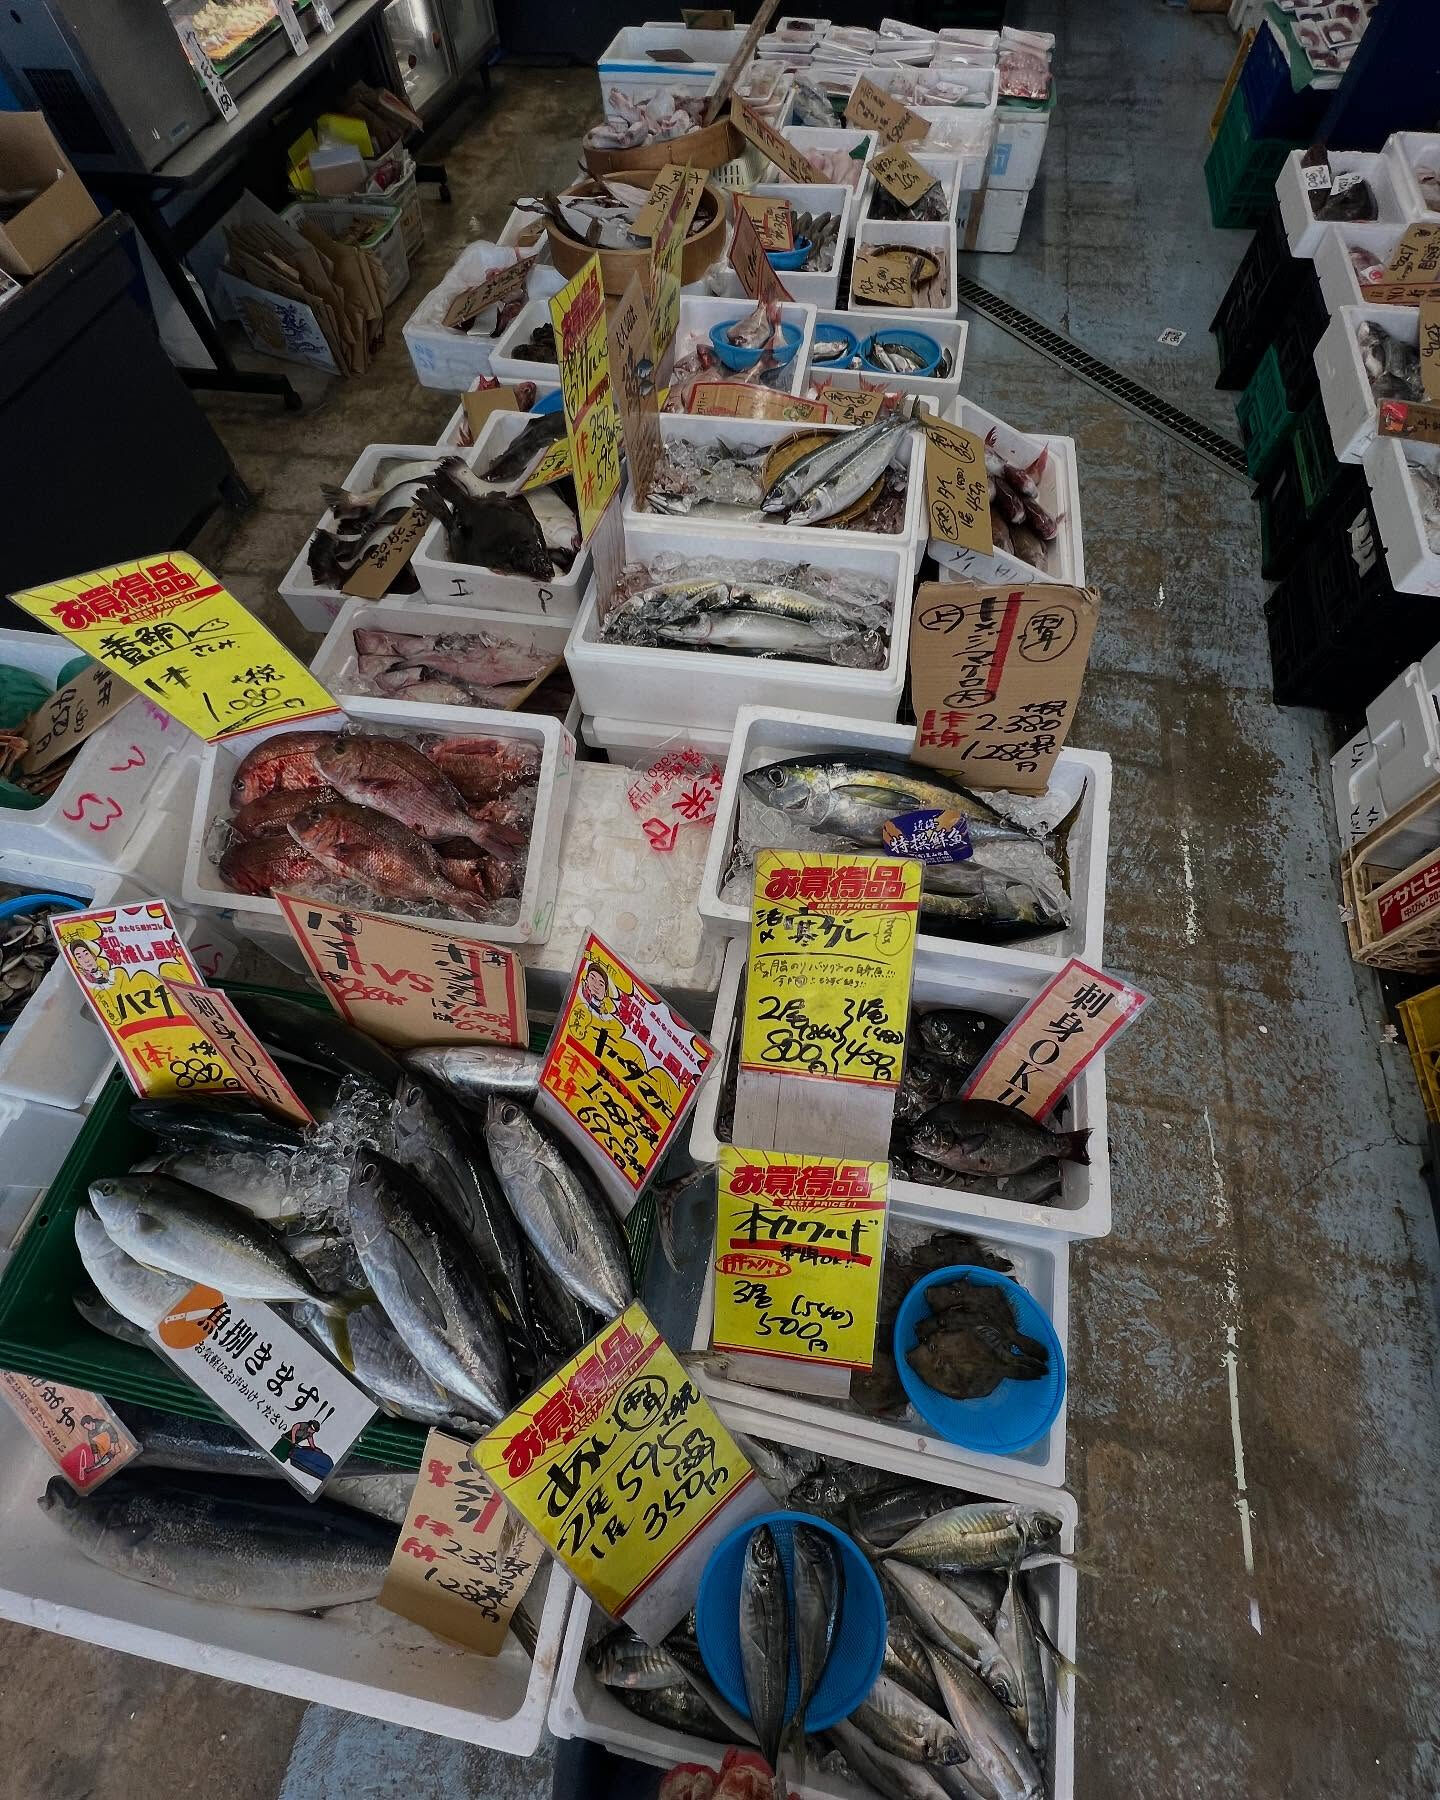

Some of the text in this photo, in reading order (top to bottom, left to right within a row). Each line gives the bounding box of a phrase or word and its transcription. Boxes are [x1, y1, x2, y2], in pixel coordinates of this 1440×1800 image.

[51, 561, 201, 630] お買得品
[764, 865, 906, 902] お買得品
[816, 902, 890, 911] BEST PRICE!!
[370, 963, 435, 993] VS
[116, 985, 175, 1020] ハマチ
[995, 980, 1115, 1112] 刺身OK!!
[728, 1164, 873, 1200] お買得品
[782, 1200, 858, 1209] BEST PRICE!!
[755, 1312, 829, 1352] 500円
[196, 1300, 336, 1425] 魚捌きます!!
[193, 1339, 289, 1432] お気軽にお声かけください
[501, 1322, 645, 1480] お買得品
